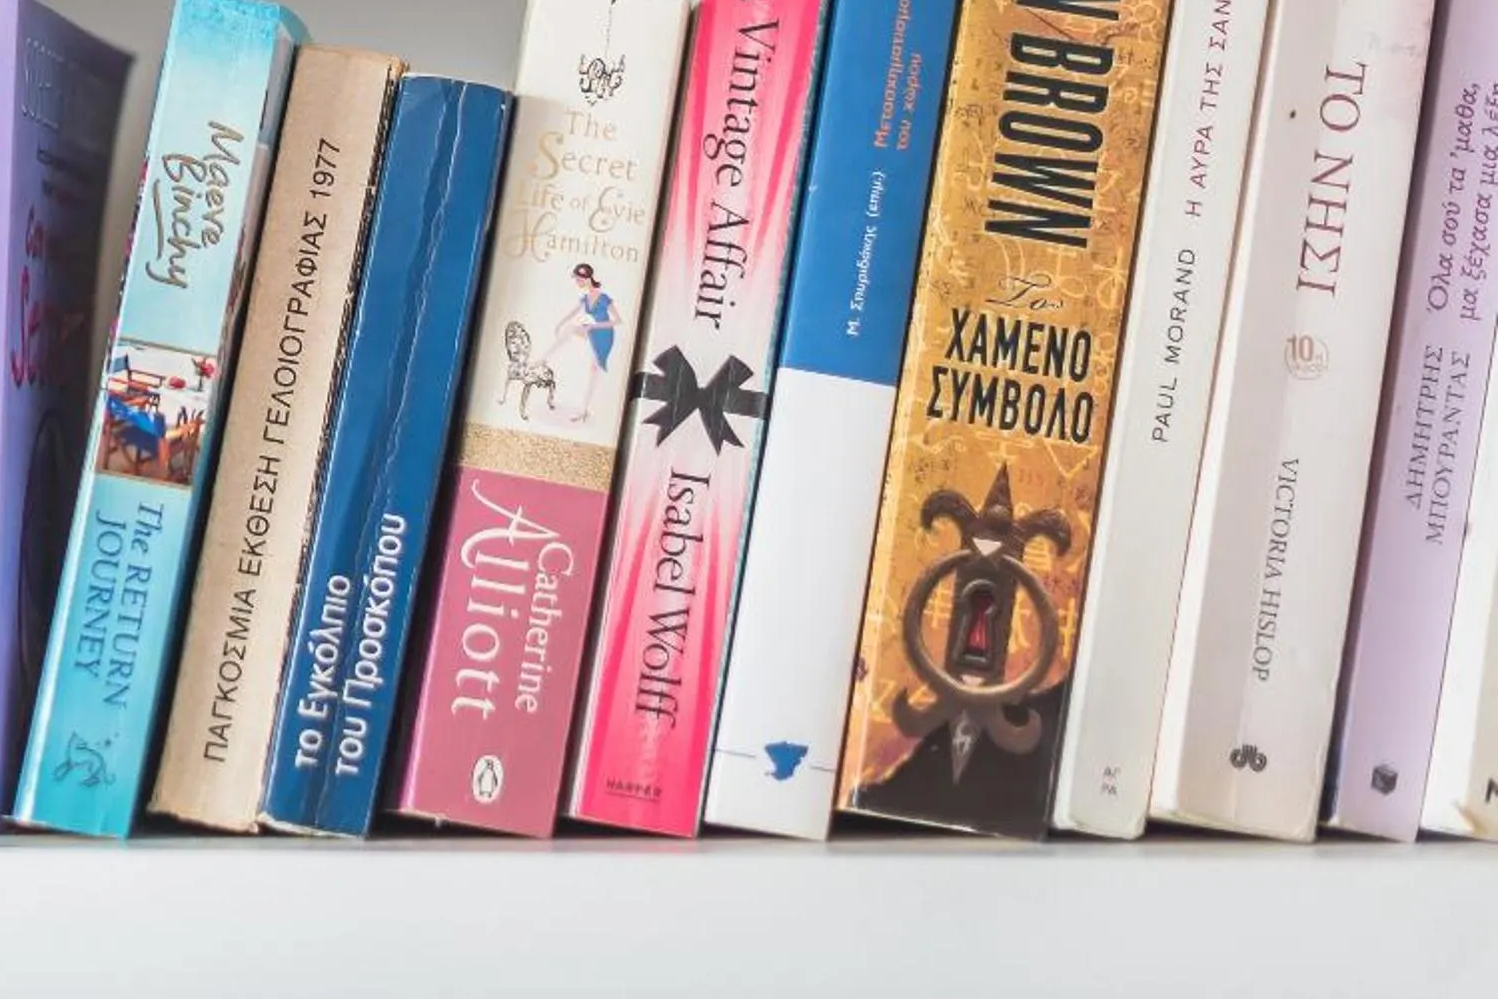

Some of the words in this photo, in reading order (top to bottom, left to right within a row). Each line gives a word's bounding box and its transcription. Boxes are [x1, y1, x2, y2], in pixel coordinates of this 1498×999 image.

[565, 108, 618, 142] The
[703, 19, 780, 187] Vintage
[984, 32, 1115, 249] BROWN
[1199, 62, 1224, 111] ΤΗΣ
[1319, 62, 1370, 132] ΤΟ
[202, 120, 244, 248] Maeve
[513, 180, 565, 211] Life
[569, 192, 588, 212] of
[588, 186, 646, 233] Evie
[524, 132, 639, 182] Secret
[1184, 200, 1202, 217] Η
[1189, 125, 1214, 190] ΑΥΡΑ
[1449, 167, 1467, 194] τα
[145, 153, 208, 288] Binchy
[501, 208, 639, 263] Hamilton
[694, 200, 752, 330] Affair
[1296, 149, 1354, 298] ΝΗΣΙ
[1461, 190, 1493, 283] ξέχασα
[944, 307, 1092, 382] ΧΑΜΕΝΟ
[1163, 249, 1196, 364] MORAND
[1459, 286, 1480, 322] μα
[202, 589, 257, 763] ΠΑΓΚΟΣΜΙΑ
[237, 455, 281, 577] ΕΚΘΕΣΗ
[262, 211, 327, 445] ΓΕΛΟΙΟΓΡΑΦΙΑΣ
[309, 138, 340, 200] 1977
[926, 365, 1094, 443] ΣΥΜΒΟΛΟ
[1151, 377, 1178, 443] PAUL
[1404, 345, 1444, 510] ΔΗΜΗΤΡΗΣ
[1425, 350, 1471, 546] ΜΠΟΥΡΑΝΤΑΣ
[131, 502, 164, 554] The
[654, 467, 712, 596] Isabel
[1263, 457, 1299, 581] VICTORIA
[73, 510, 127, 678] JOURNEY
[102, 564, 152, 710] RETURN
[297, 575, 351, 718] Εγκόλπιο
[342, 513, 405, 708] Προσκόπου
[451, 481, 560, 720] Alliott
[515, 542, 574, 714] Catherine
[1252, 589, 1282, 682] HISLOP
[634, 607, 696, 728] Wolff
[335, 717, 367, 776] του
[605, 779, 664, 797] HARPER
